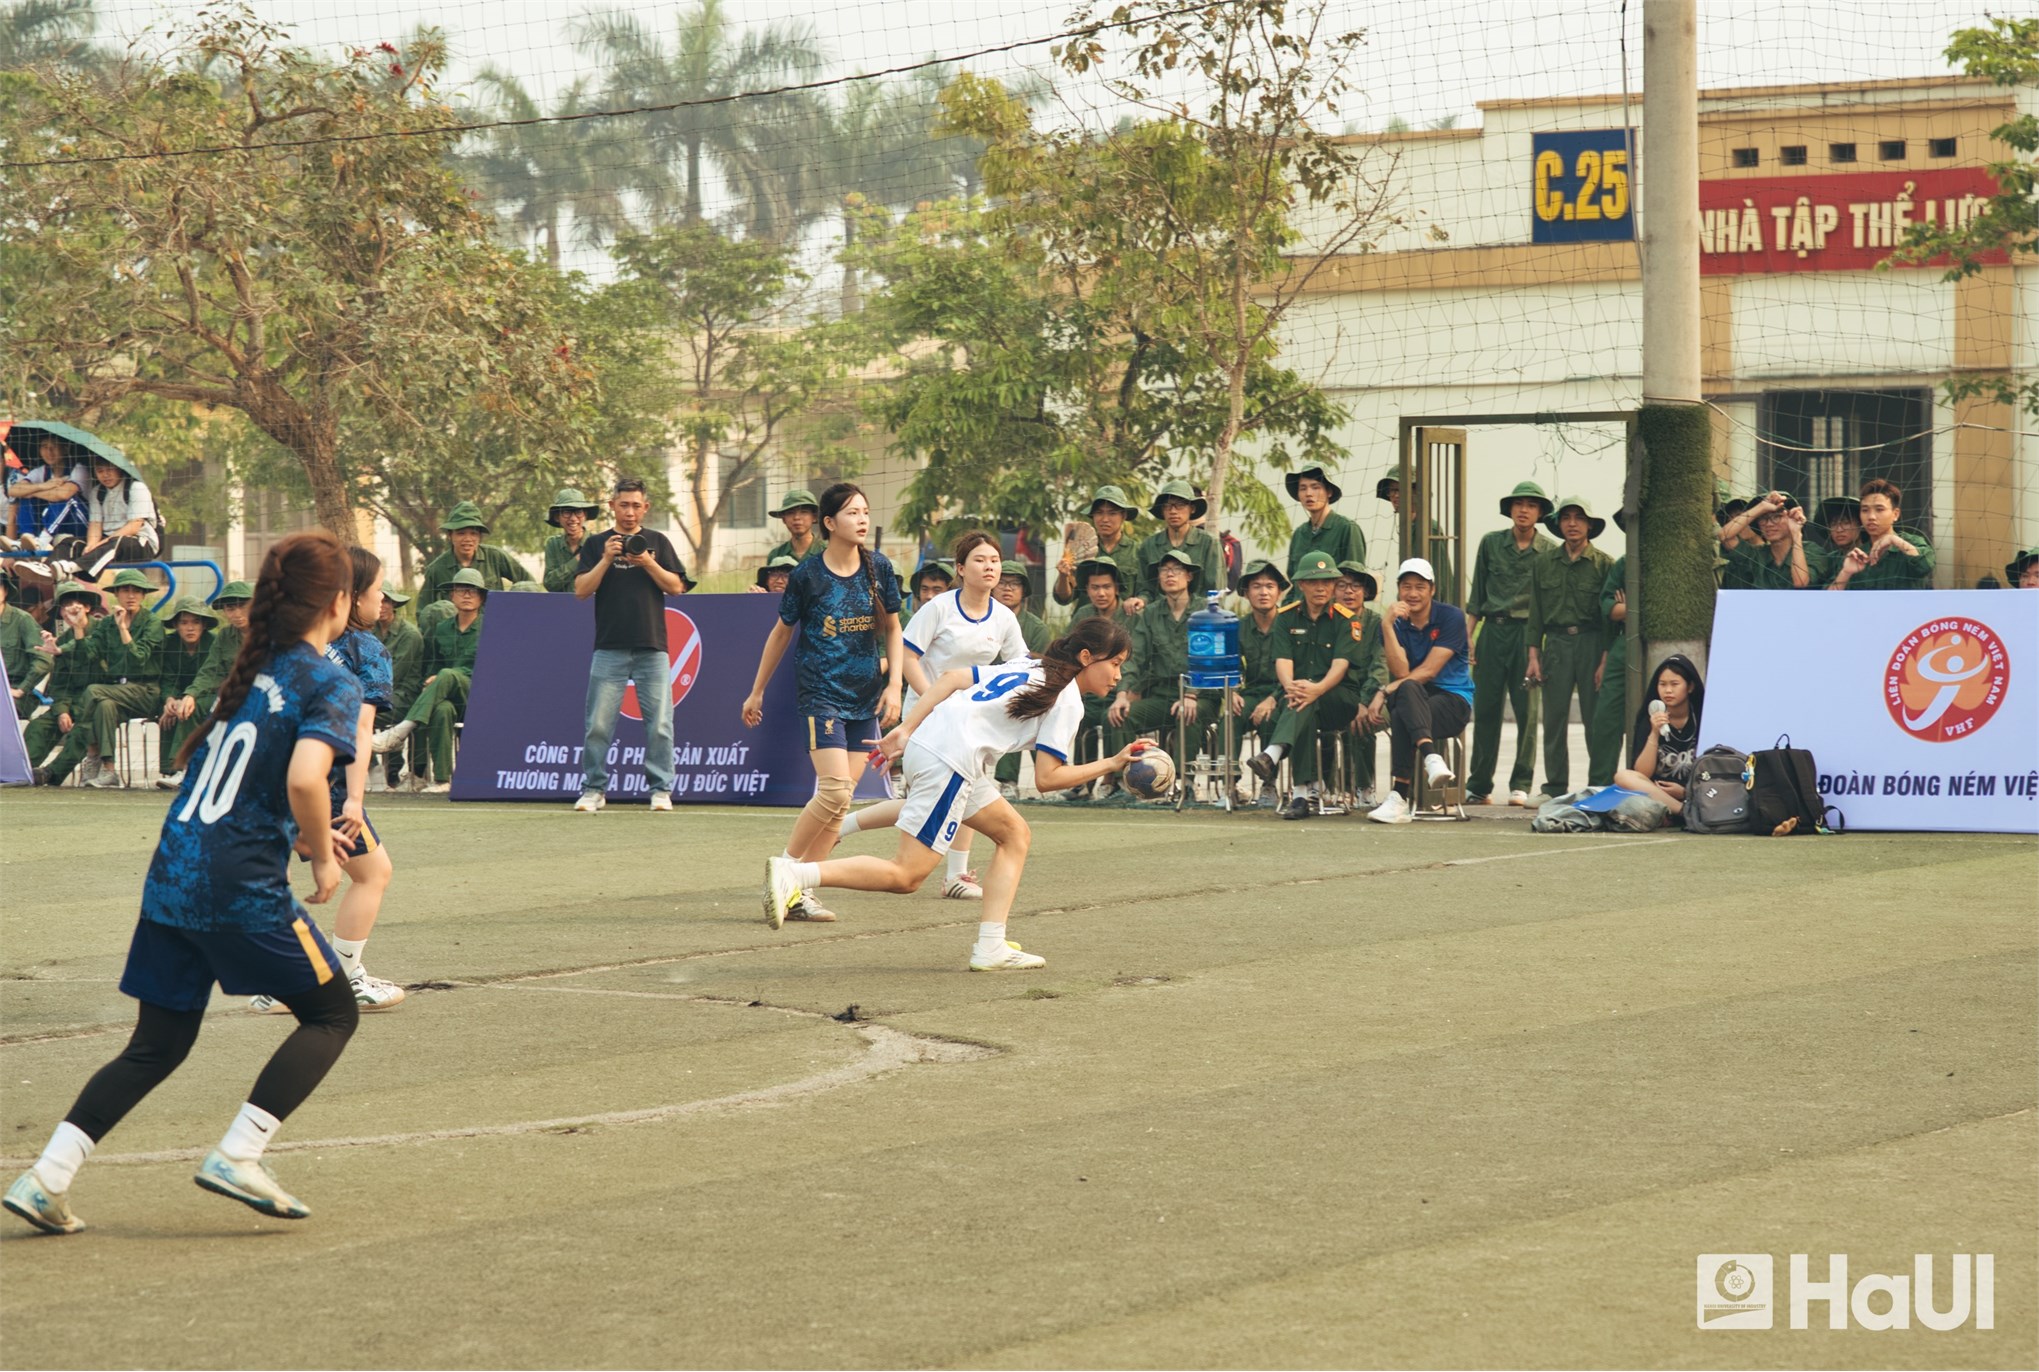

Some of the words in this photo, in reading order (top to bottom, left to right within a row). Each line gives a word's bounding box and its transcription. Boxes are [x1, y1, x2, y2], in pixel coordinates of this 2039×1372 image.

[1535, 150, 1629, 222] C.25
[1699, 198, 1763, 253] NHÀ
[1771, 196, 1839, 258] TẬP
[1848, 181, 1916, 248] THỂ
[1888, 676, 1901, 705] LIÊN
[1921, 621, 1958, 638] BÓNG
[1962, 622, 1989, 641] NÉM
[1986, 676, 2003, 705] NAM
[971, 672, 1030, 702] 9
[1945, 717, 1975, 737] VHF
[525, 741, 569, 764] CÔNG
[574, 746, 584, 765] T
[606, 739, 621, 765] Ổ
[673, 742, 703, 765] SẢN
[705, 741, 749, 765] XUẤT
[177, 720, 258, 825] 10
[497, 769, 560, 790] THƯƠNG
[563, 773, 588, 795] MẠ
[622, 773, 650, 796] DỊC
[693, 770, 728, 792] ĐỨC
[733, 769, 770, 796] VIỆT
[1817, 770, 1875, 796] ĐOÀN
[1882, 771, 1941, 796] BÓNG
[1948, 771, 1996, 796] NÉM
[2004, 770, 2039, 800] VIỆ
[944, 821, 959, 842] 9
